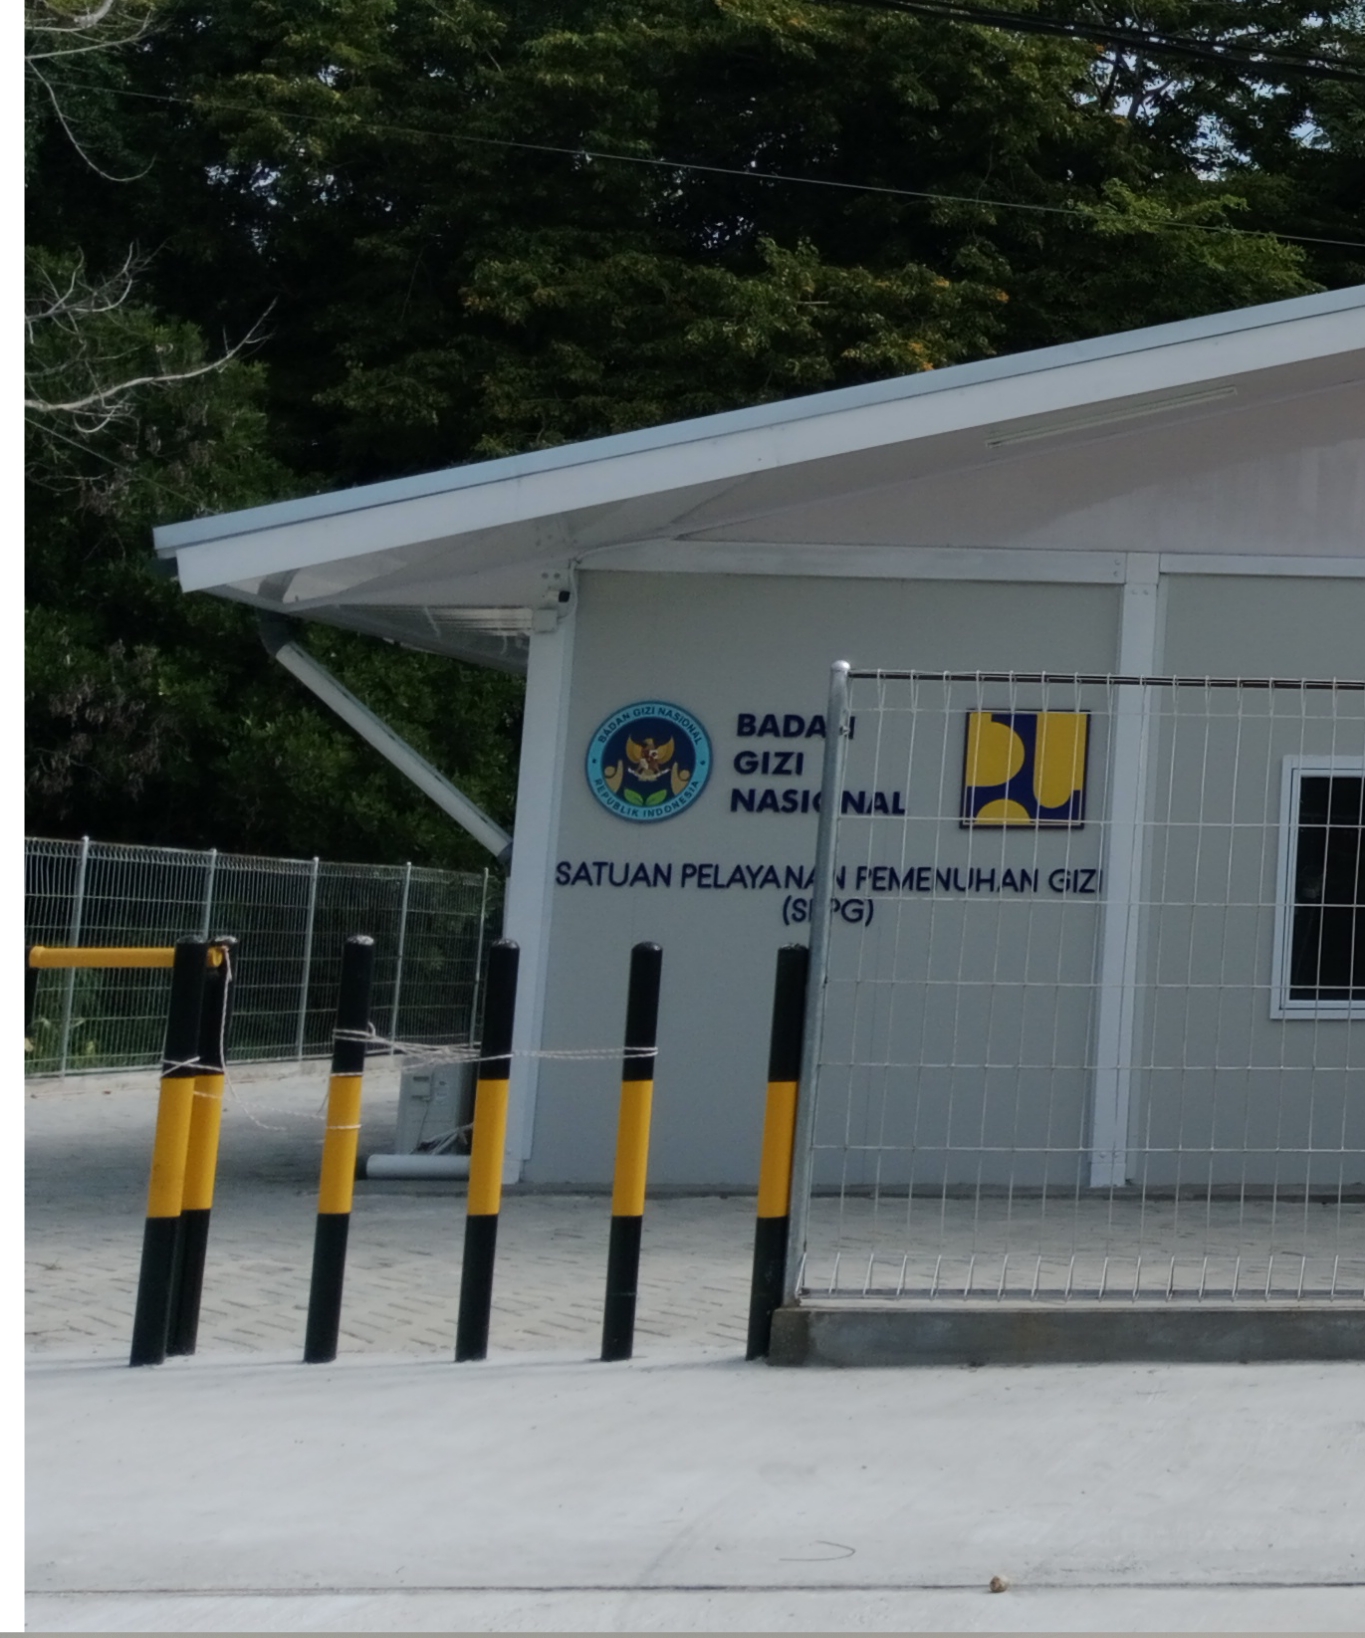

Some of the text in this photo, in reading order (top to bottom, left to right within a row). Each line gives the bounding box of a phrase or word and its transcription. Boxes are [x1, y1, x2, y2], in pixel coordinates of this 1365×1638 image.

[597, 706, 703, 746] BADAN GIZI NASIONAL
[736, 713, 856, 740] BADA
[733, 750, 804, 776] GIZI
[594, 778, 699, 818] REPUBLIK INDONESIA
[556, 861, 672, 888] SATUAN
[856, 866, 1038, 894] PEMENUHAN
